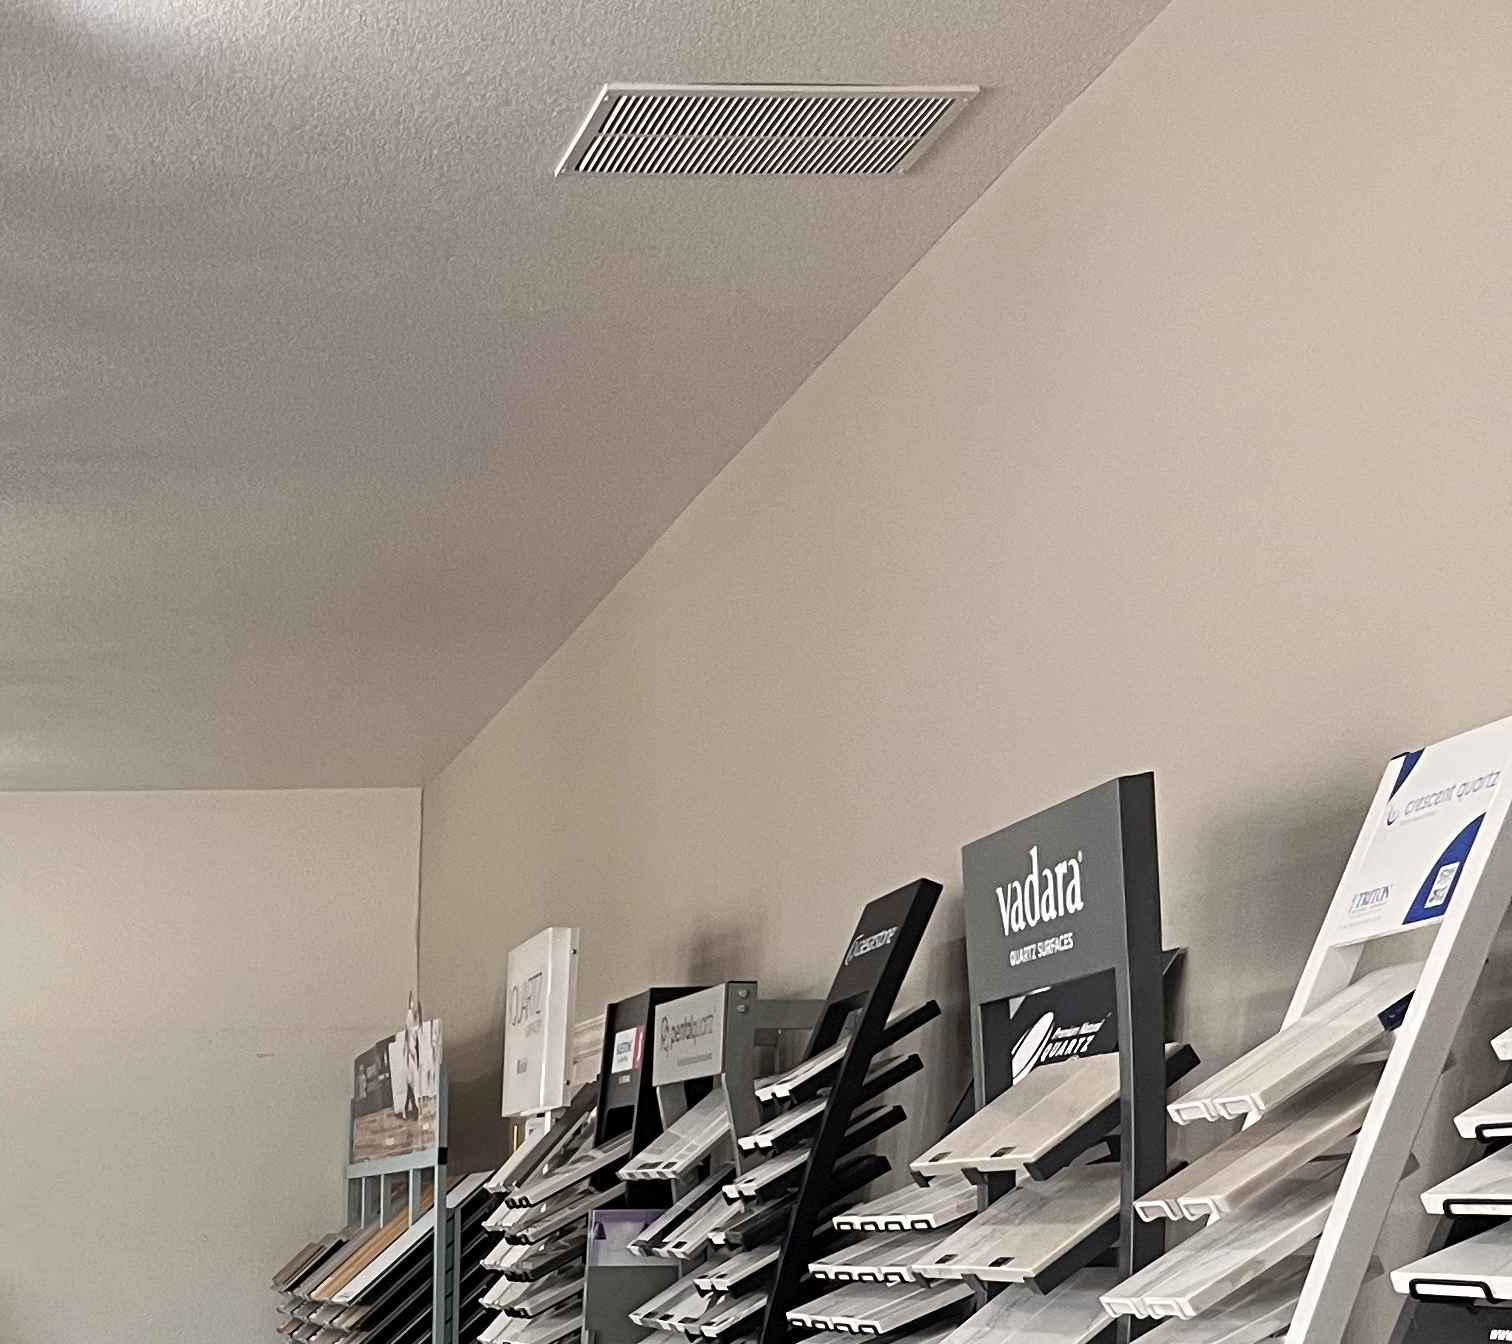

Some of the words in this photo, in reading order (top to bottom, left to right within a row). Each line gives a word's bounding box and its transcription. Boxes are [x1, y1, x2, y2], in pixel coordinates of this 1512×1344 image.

[995, 846, 1084, 936] vadara
[1009, 943, 1037, 966] QUARTZ
[1037, 932, 1074, 958] SURFACES
